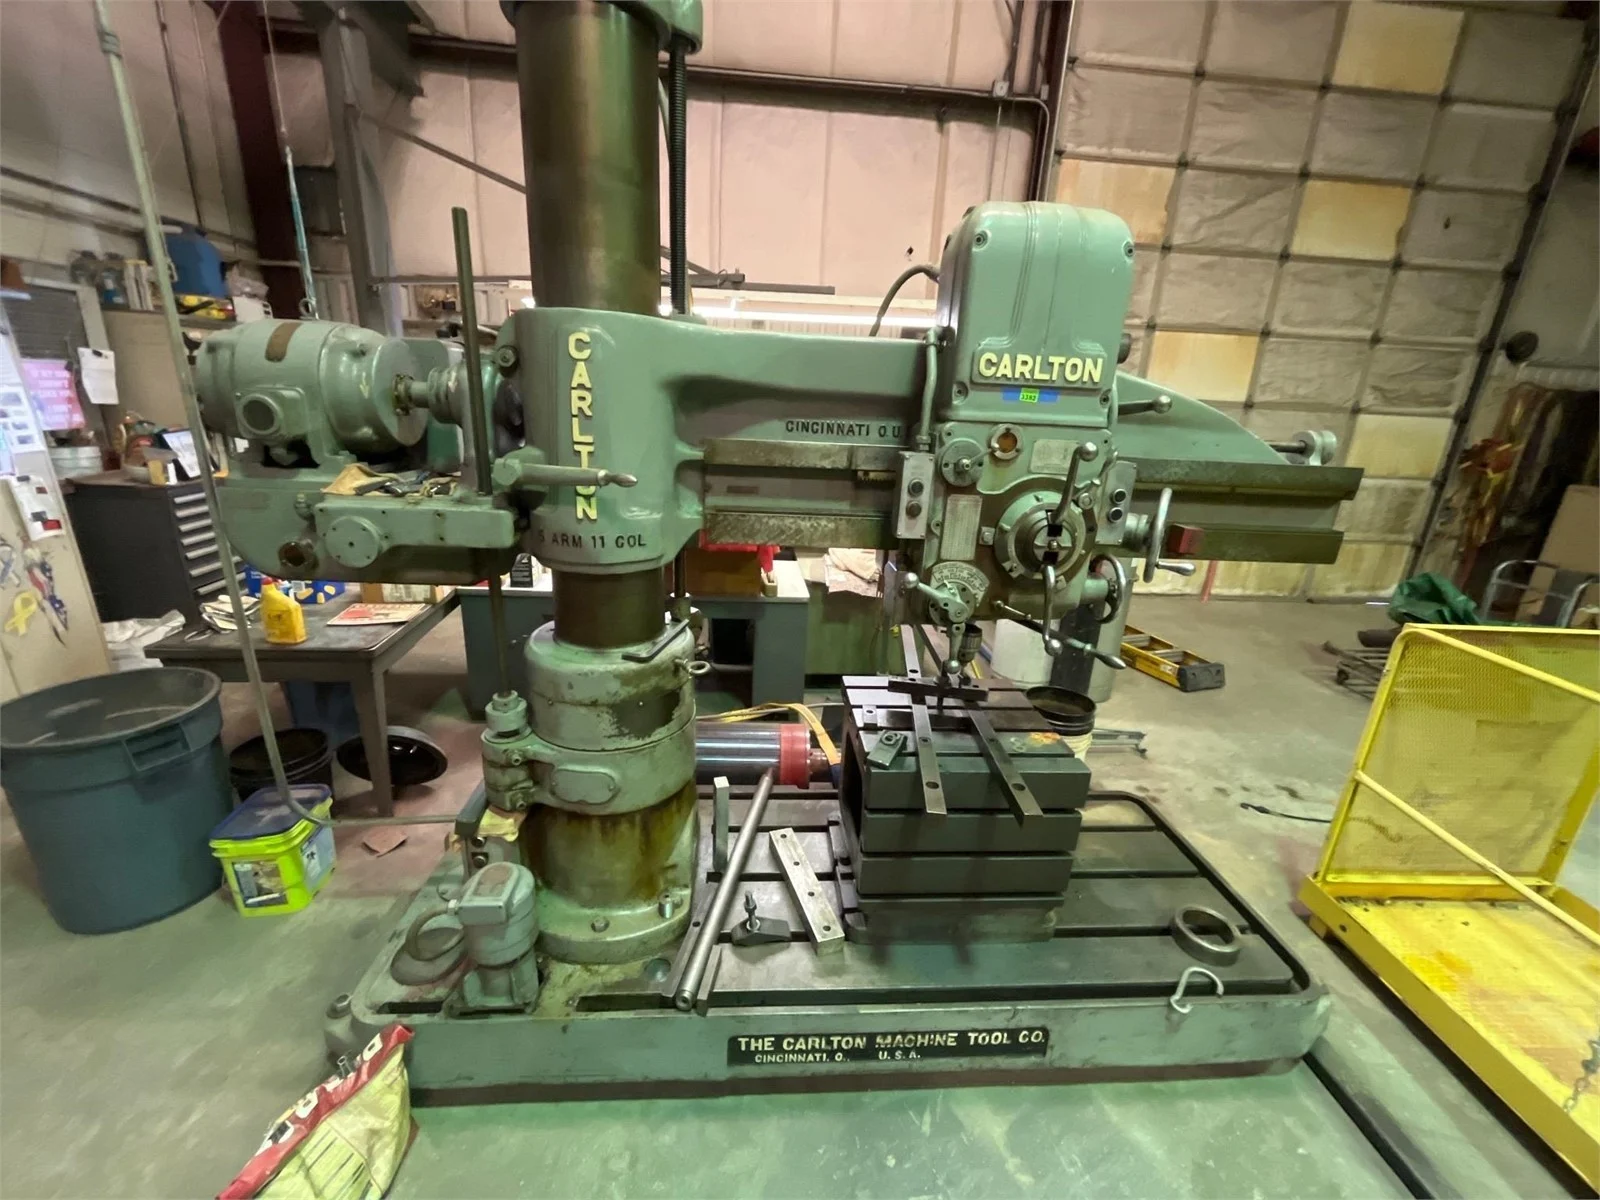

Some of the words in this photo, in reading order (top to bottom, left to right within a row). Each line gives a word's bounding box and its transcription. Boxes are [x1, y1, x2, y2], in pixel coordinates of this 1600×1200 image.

[979, 352, 1103, 383] CARLTON
[785, 420, 870, 437] CINCINNATI
[552, 533, 582, 549] ARM
[591, 535, 606, 549] 11
[737, 1037, 775, 1052] THE
[782, 1036, 866, 1051] CARLTON
[875, 1033, 957, 1049] MACHINE
[968, 1031, 1011, 1046] TOOL
[1018, 1030, 1046, 1044] CO.
